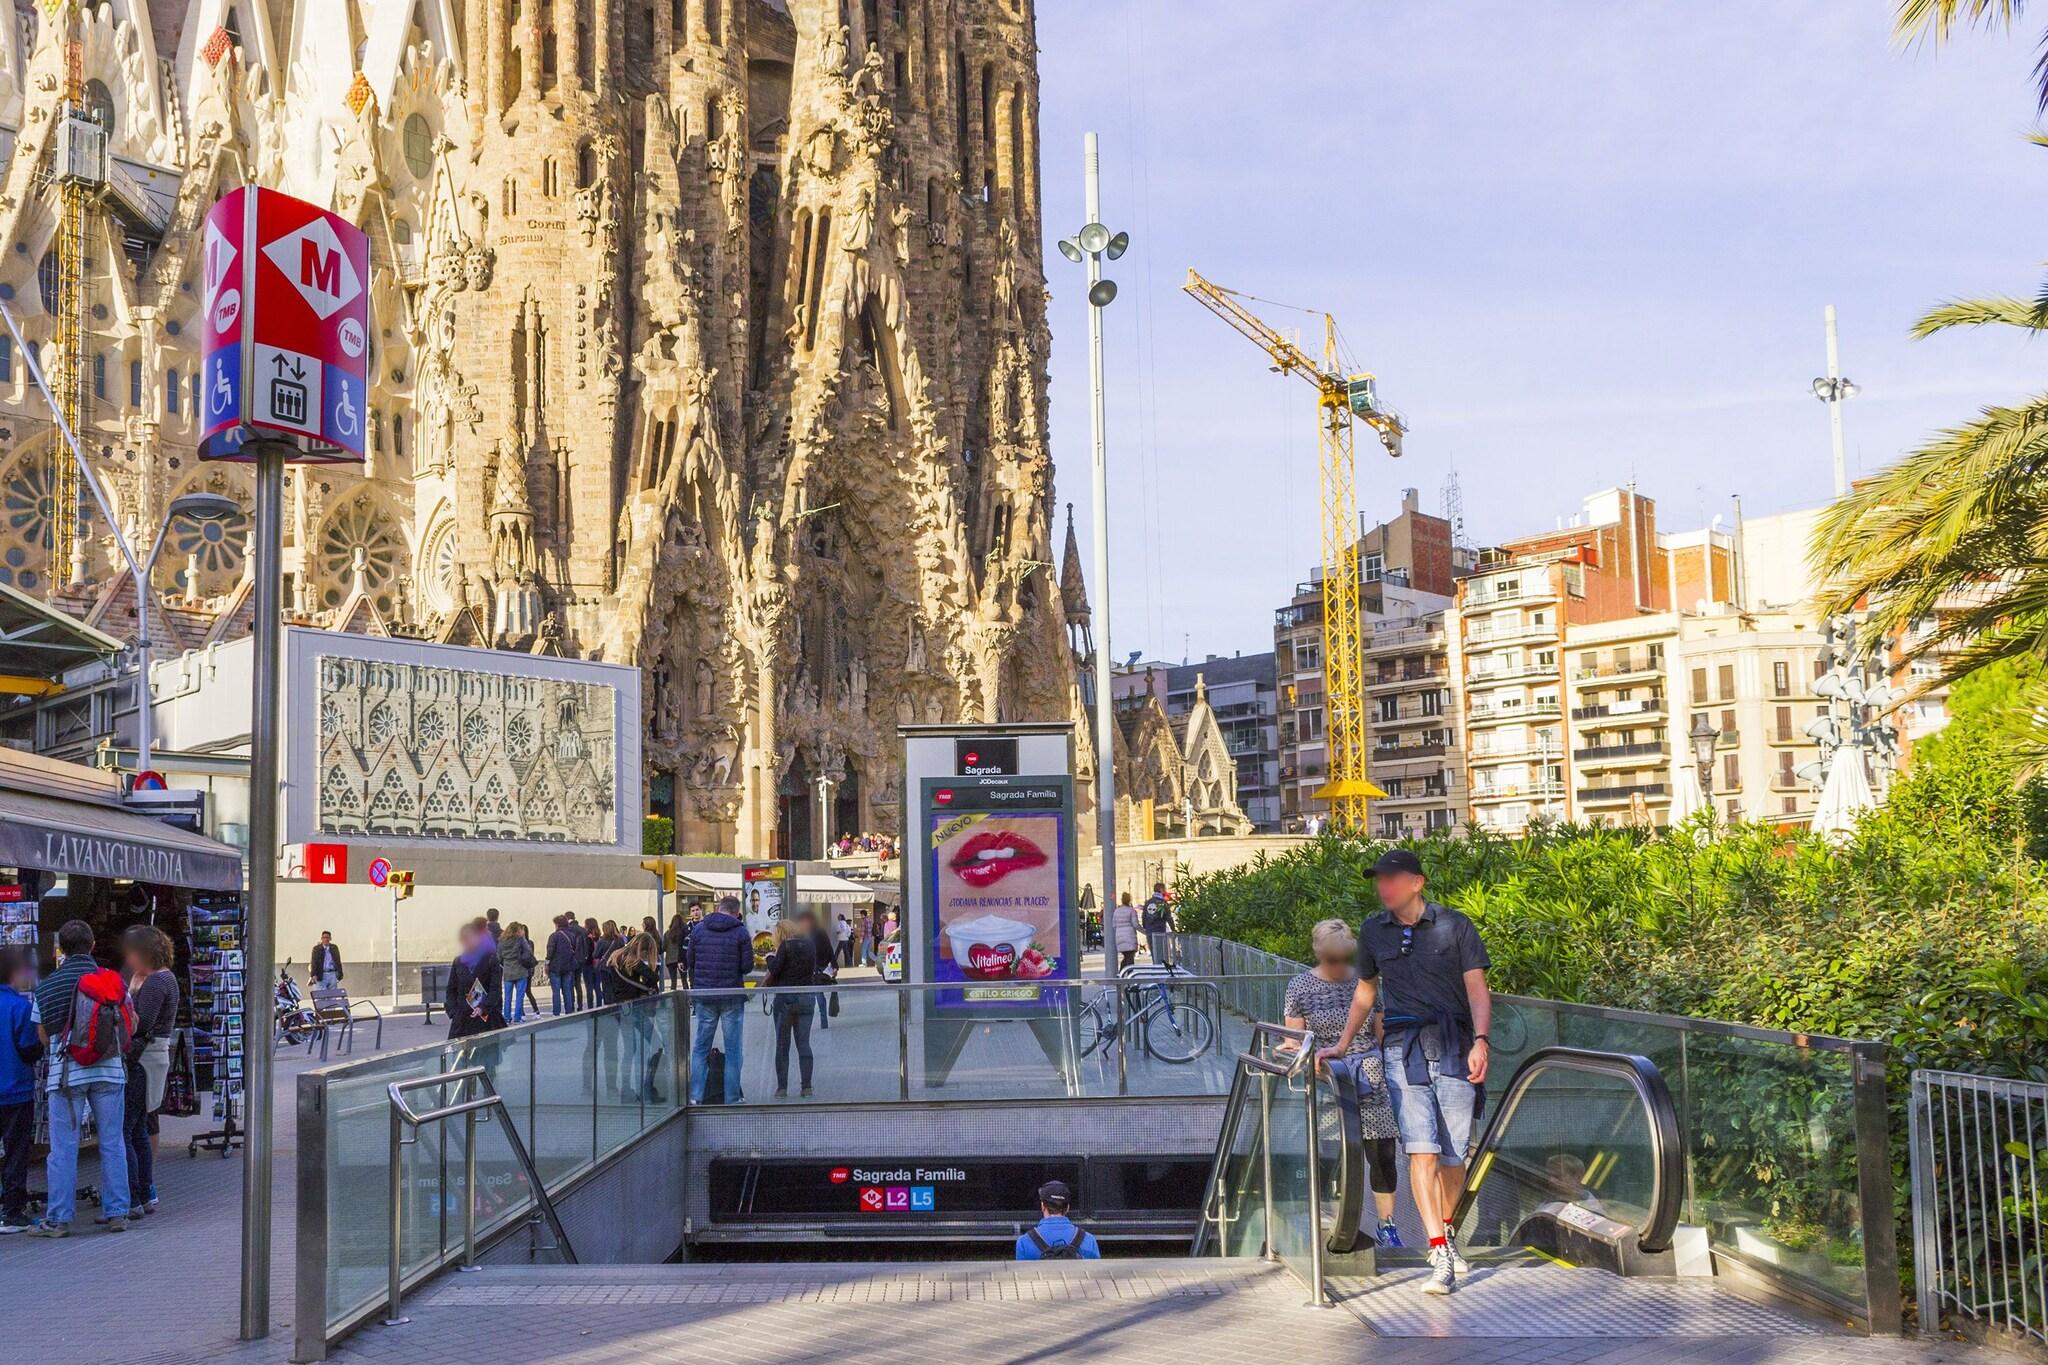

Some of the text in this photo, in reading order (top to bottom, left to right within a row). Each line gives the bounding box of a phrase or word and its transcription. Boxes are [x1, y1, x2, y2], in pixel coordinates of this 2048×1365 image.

[301, 237, 341, 299] M
[218, 303, 237, 321] TMB
[344, 329, 362, 349] TMB
[965, 766, 1002, 776] Sagrada
[990, 791, 1025, 800] Sagrada
[935, 816, 972, 842] NUEVO
[46, 833, 184, 881] LA VANGUARDIA
[971, 952, 1013, 969] Vitalinea
[969, 988, 1033, 999] ESTILO GRIEGO
[852, 1168, 911, 1184] Sagrada
[915, 1167, 966, 1181] Família
[886, 1192, 907, 1206] L2
[912, 1192, 932, 1206] L5
